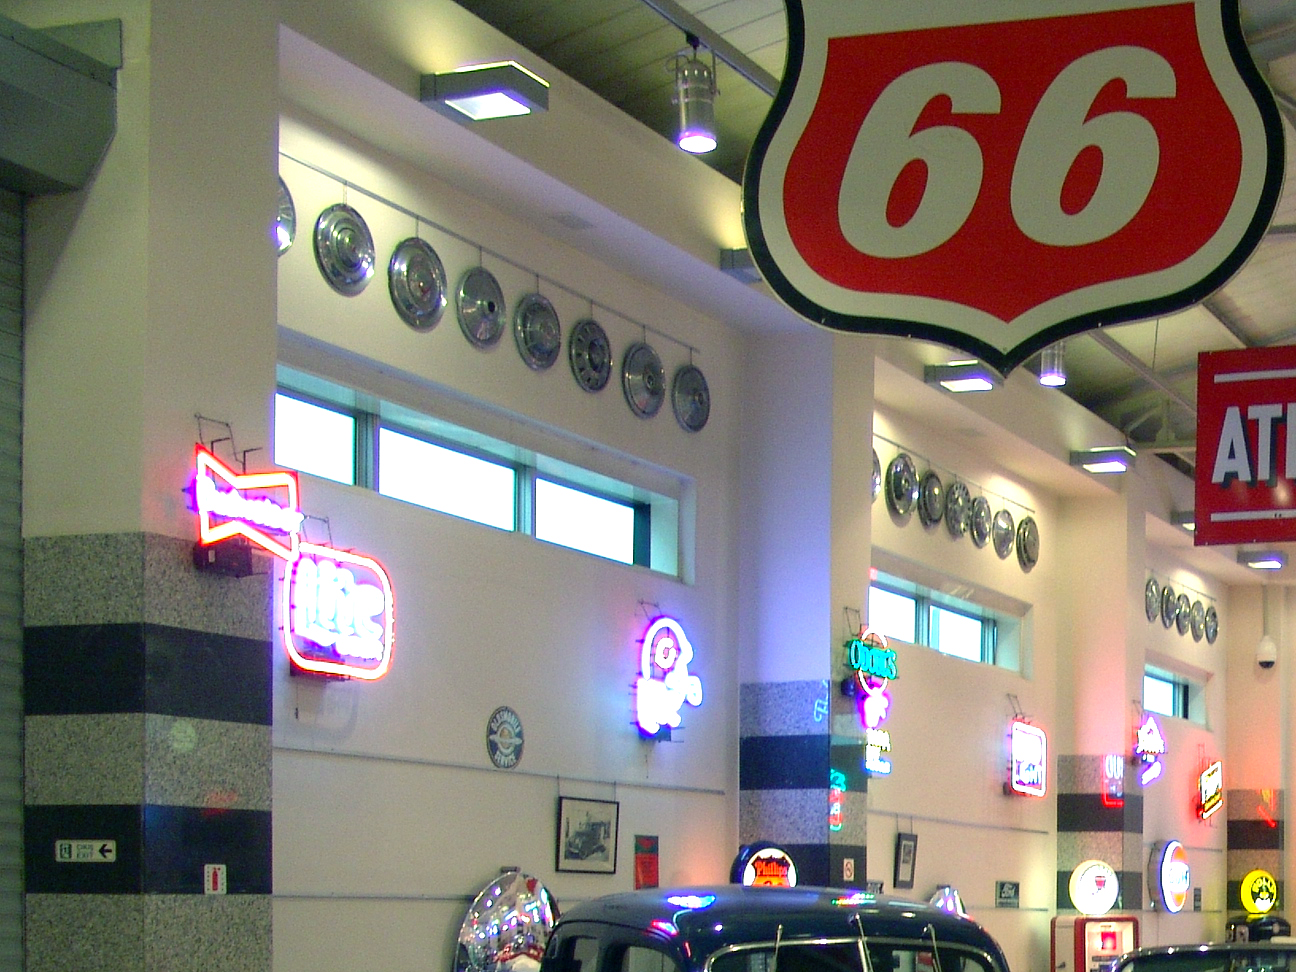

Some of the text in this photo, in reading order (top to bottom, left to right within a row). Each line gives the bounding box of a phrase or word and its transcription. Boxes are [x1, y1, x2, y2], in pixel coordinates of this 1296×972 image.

[837, 44, 1178, 260] 66
[490, 709, 521, 732] OLDSMOBILE
[494, 750, 517, 768] SERVICE
